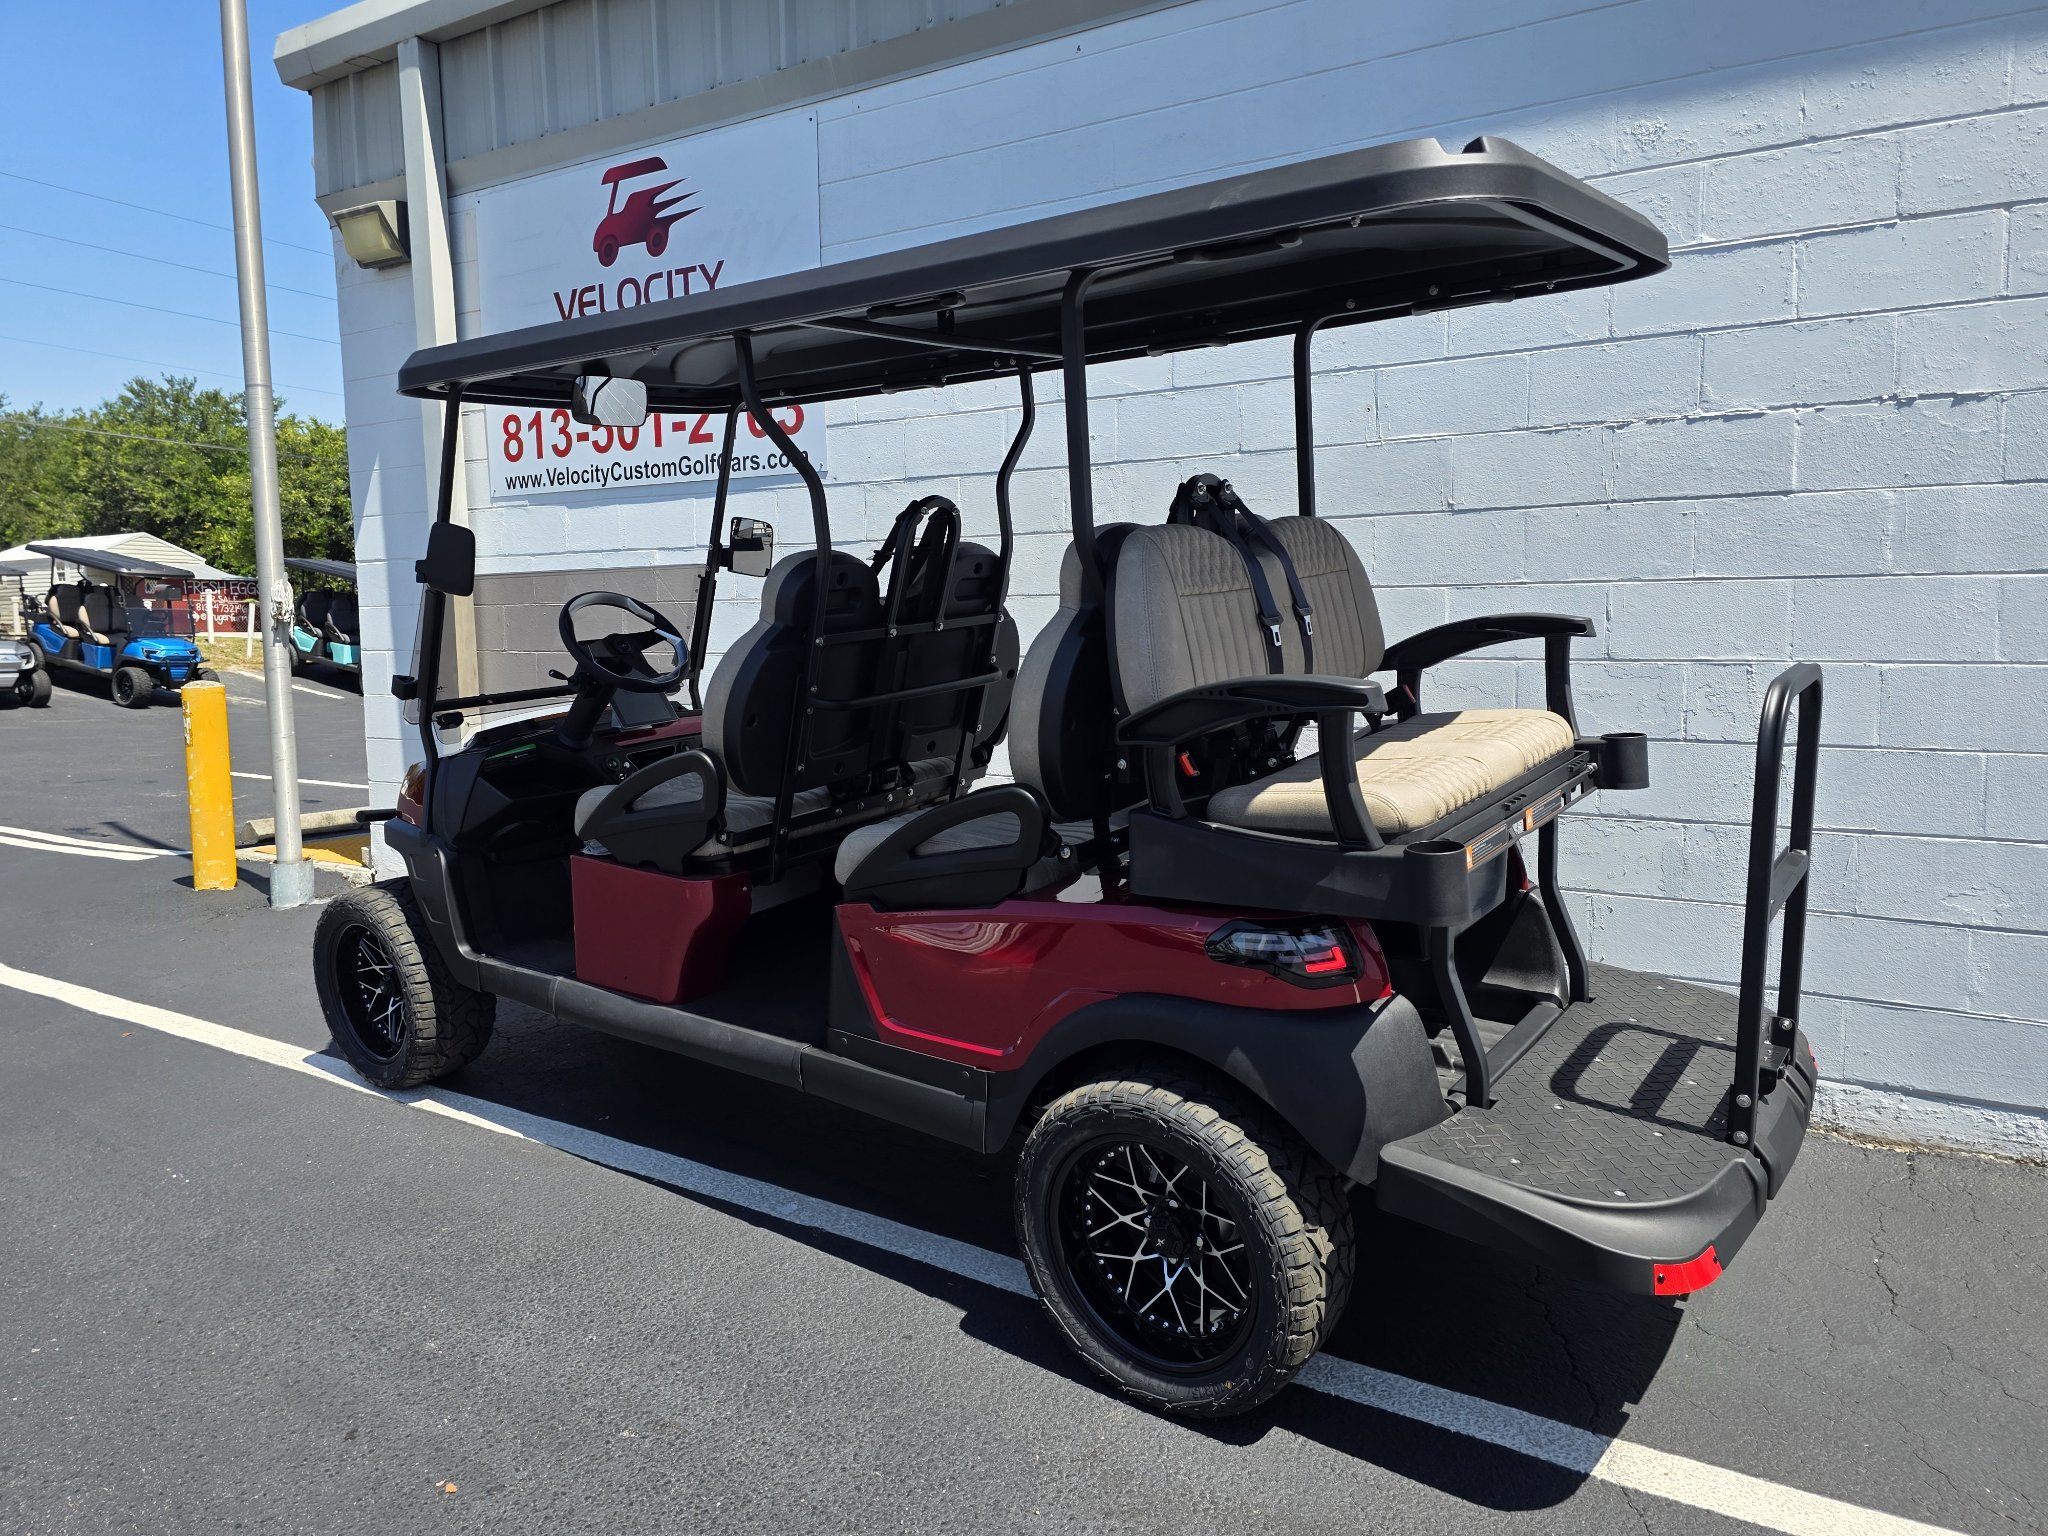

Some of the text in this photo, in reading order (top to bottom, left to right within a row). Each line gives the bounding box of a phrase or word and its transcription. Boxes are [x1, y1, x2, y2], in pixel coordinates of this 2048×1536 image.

[553, 260, 725, 321] VELOCITY
[502, 404, 805, 463] 813-501-23
[505, 450, 809, 490] www.VelocityCustomGolfars.co
[183, 580, 260, 595] FRESH EGG
[199, 595, 216, 604] FR
